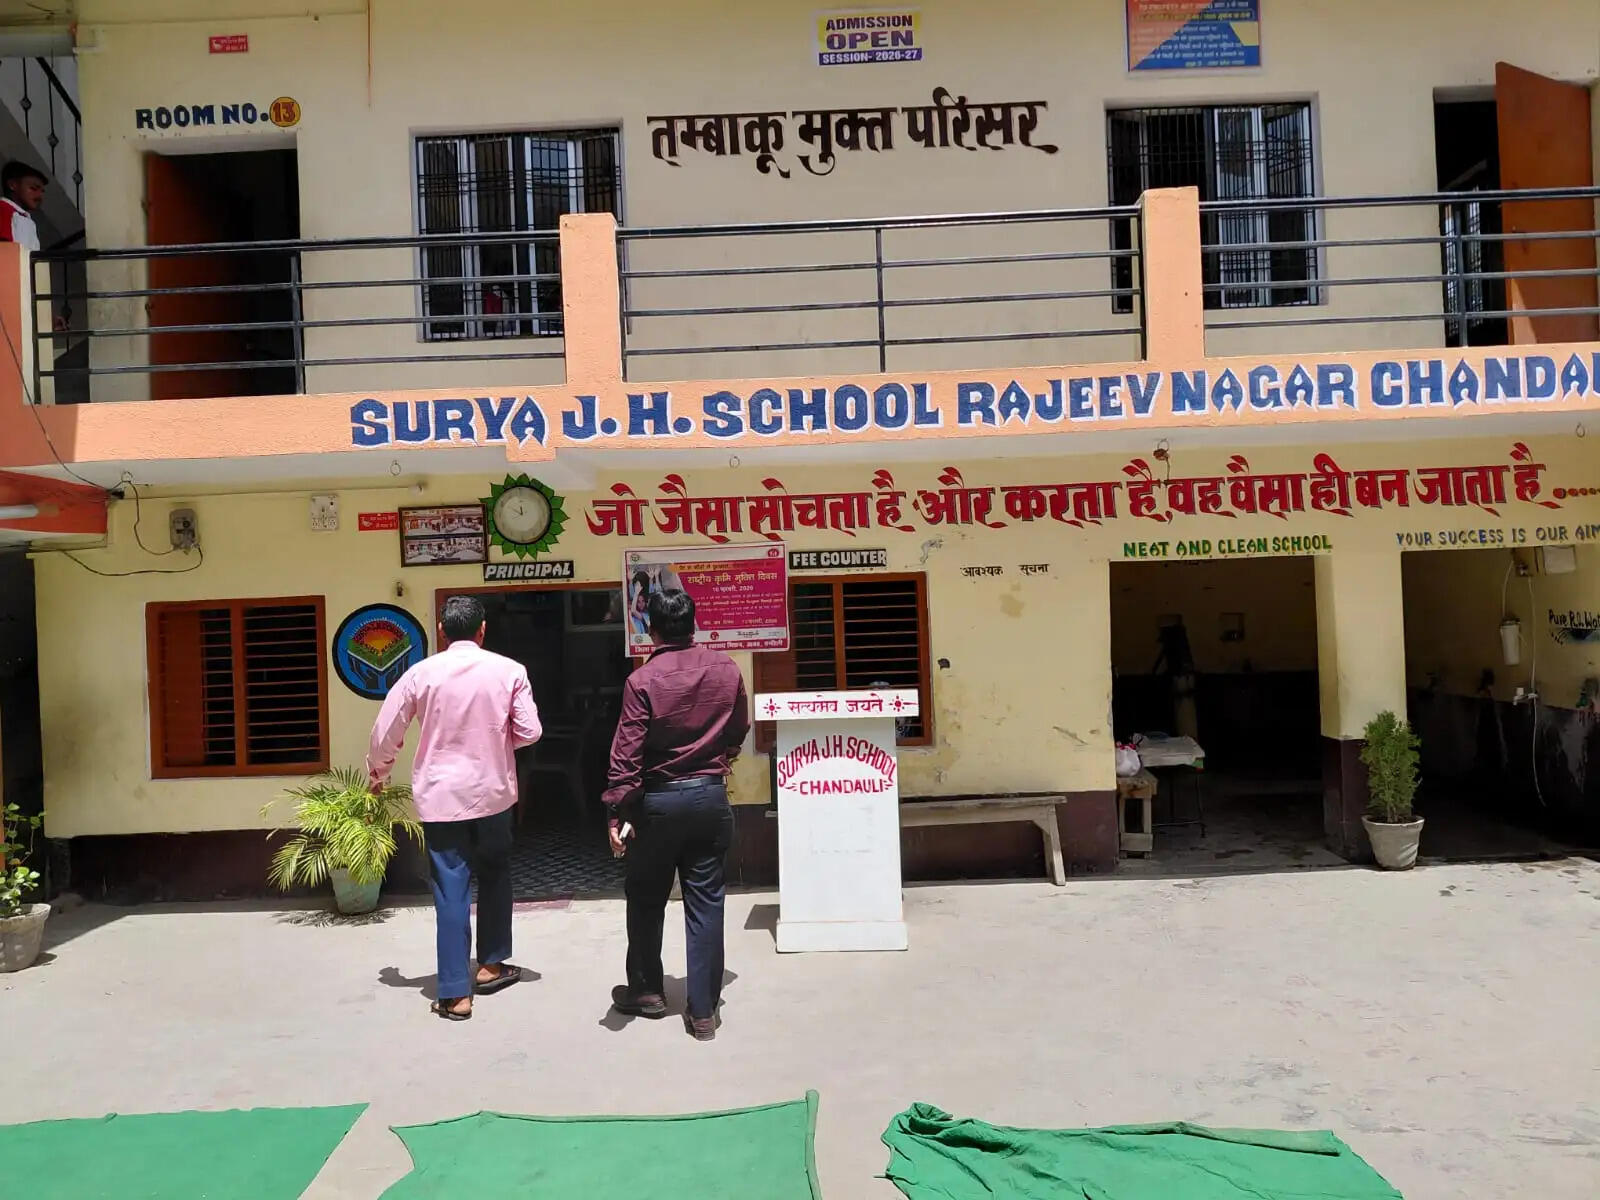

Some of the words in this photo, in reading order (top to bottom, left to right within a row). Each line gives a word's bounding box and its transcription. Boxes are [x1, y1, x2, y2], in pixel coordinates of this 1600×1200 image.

[826, 15, 912, 31] ADMISSION
[826, 30, 914, 50] OPEN
[135, 104, 216, 131] ROOM
[221, 103, 269, 125] NO.
[272, 101, 296, 123] 13
[647, 111, 791, 179] तम्बाकू
[792, 107, 898, 176] मुक्त
[901, 86, 1059, 154] परिसर
[350, 395, 547, 449] SURYA
[702, 381, 943, 441] SCHOOL
[957, 371, 1161, 427] RAJEEV
[1171, 363, 1358, 416] NAGAR
[1371, 352, 1600, 414] CHANDA
[584, 482, 650, 537] जो
[652, 473, 745, 544] जैसा
[746, 478, 873, 541] सोचता
[912, 466, 1009, 528] और
[1000, 481, 1123, 529] करता
[1164, 477, 1238, 519] वह
[1225, 454, 1308, 521] वैसा
[1309, 452, 1355, 518] ही
[1353, 469, 1410, 509] बन
[1413, 465, 1511, 518] जाता
[1123, 541, 1170, 558] NEAT
[1176, 539, 1212, 557] AND
[1218, 536, 1268, 554] CLEAN
[1272, 534, 1333, 552] SCHOOL
[1396, 531, 1433, 546] YOUR
[1438, 528, 1504, 544] SUCCESS
[1511, 527, 1527, 543] IS
[1535, 526, 1569, 541] OUR
[792, 552, 817, 567] FEE
[820, 550, 887, 566] COUNTER
[484, 562, 571, 579] PRINCIPAL
[960, 566, 1004, 578] आवश्यक
[1018, 563, 1050, 577] सूचना
[845, 693, 884, 714] जयते
[778, 739, 820, 788] SURYA
[846, 736, 897, 783] SCHOOL
[800, 778, 884, 795] CHANDAULI
